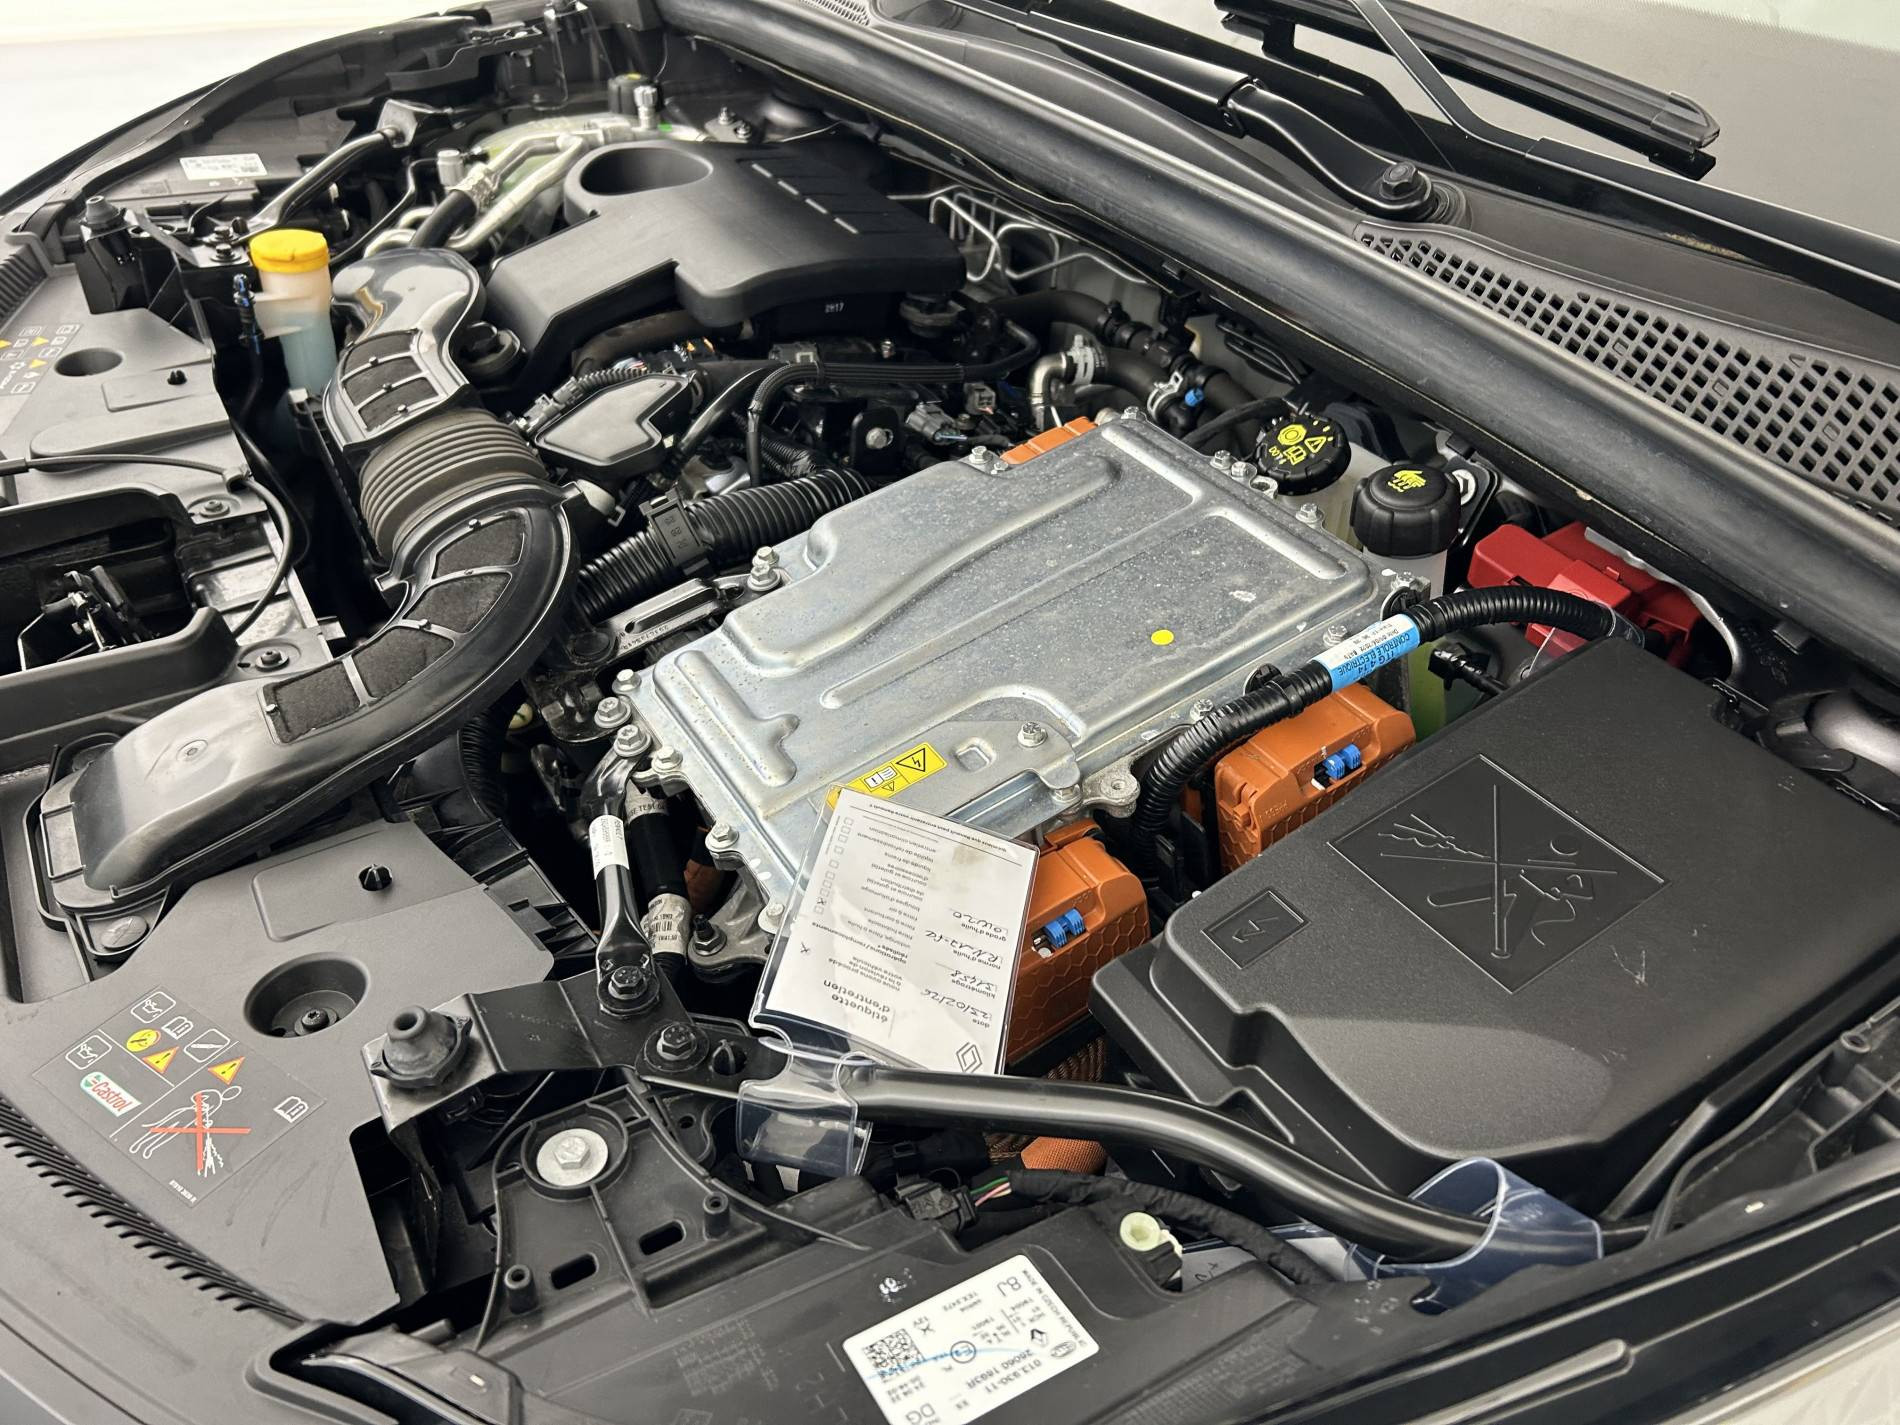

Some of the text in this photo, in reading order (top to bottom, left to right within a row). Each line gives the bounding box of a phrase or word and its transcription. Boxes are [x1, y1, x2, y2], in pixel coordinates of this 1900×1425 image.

[1378, 632, 1410, 651] CONTROLE
[1338, 646, 1377, 676] ELECTRIQUE
[960, 922, 1006, 941] grade d'huile
[952, 949, 1000, 970] norme d'huile
[822, 979, 890, 1013] d'entretien
[951, 978, 995, 999] kilométrage
[830, 993, 888, 1023] étiquette
[971, 1018, 989, 1029] date
[92, 1081, 133, 1112] Castrol
[997, 1276, 1022, 1296] 8J
